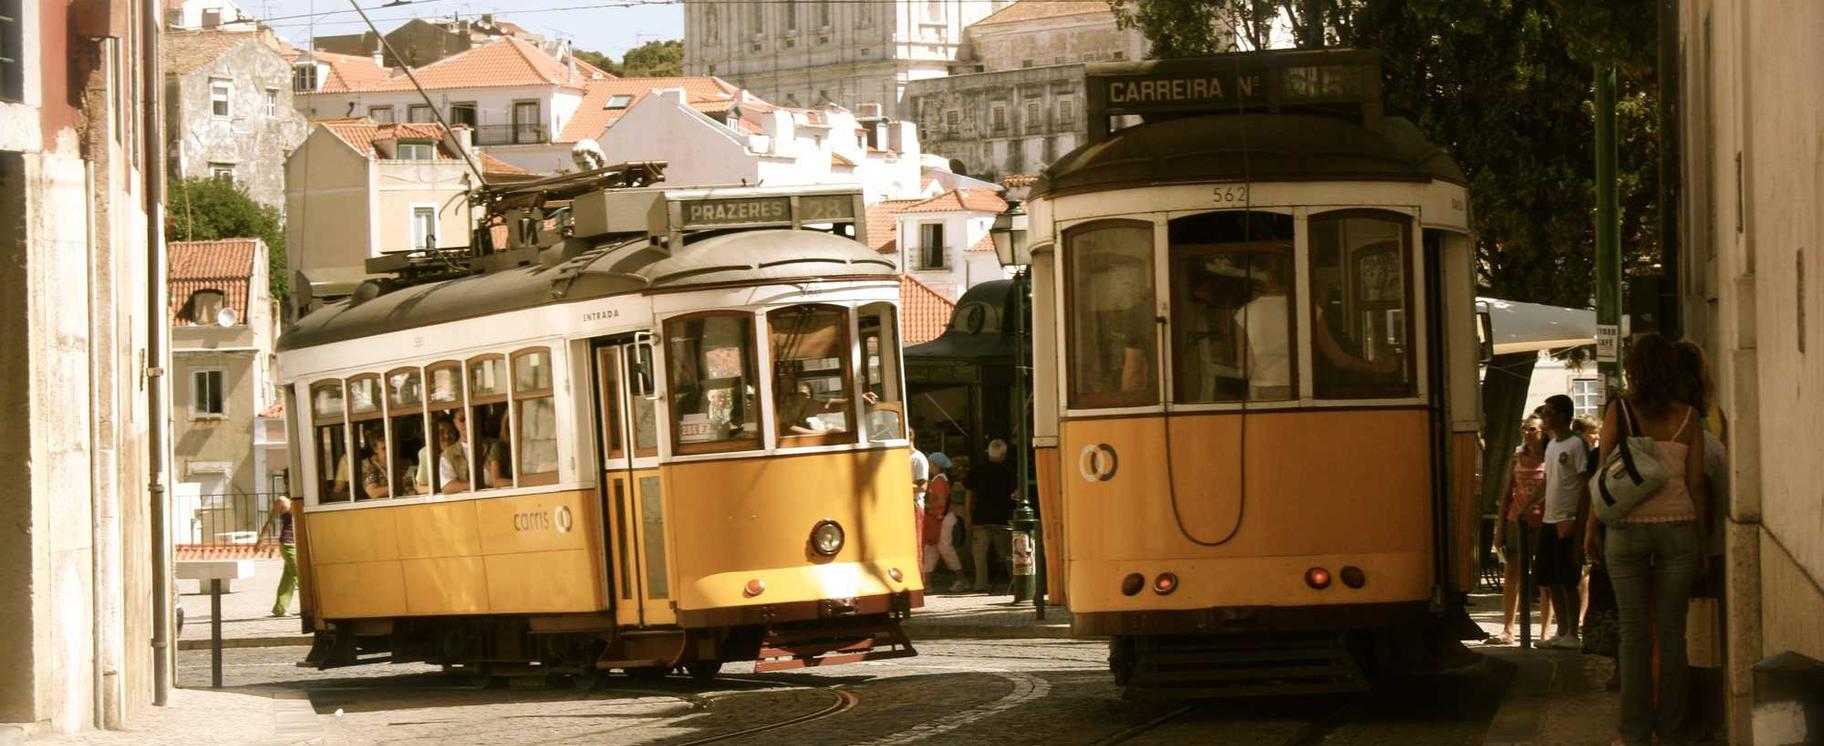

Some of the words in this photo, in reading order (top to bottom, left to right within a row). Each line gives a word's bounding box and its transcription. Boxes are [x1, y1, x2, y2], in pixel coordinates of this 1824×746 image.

[1109, 77, 1223, 103] CARREIRA
[1213, 186, 1246, 202] 562
[690, 201, 783, 221] PRAZERES
[807, 201, 842, 219] 28
[583, 309, 619, 322] ENTRADA
[513, 503, 549, 532] carris
